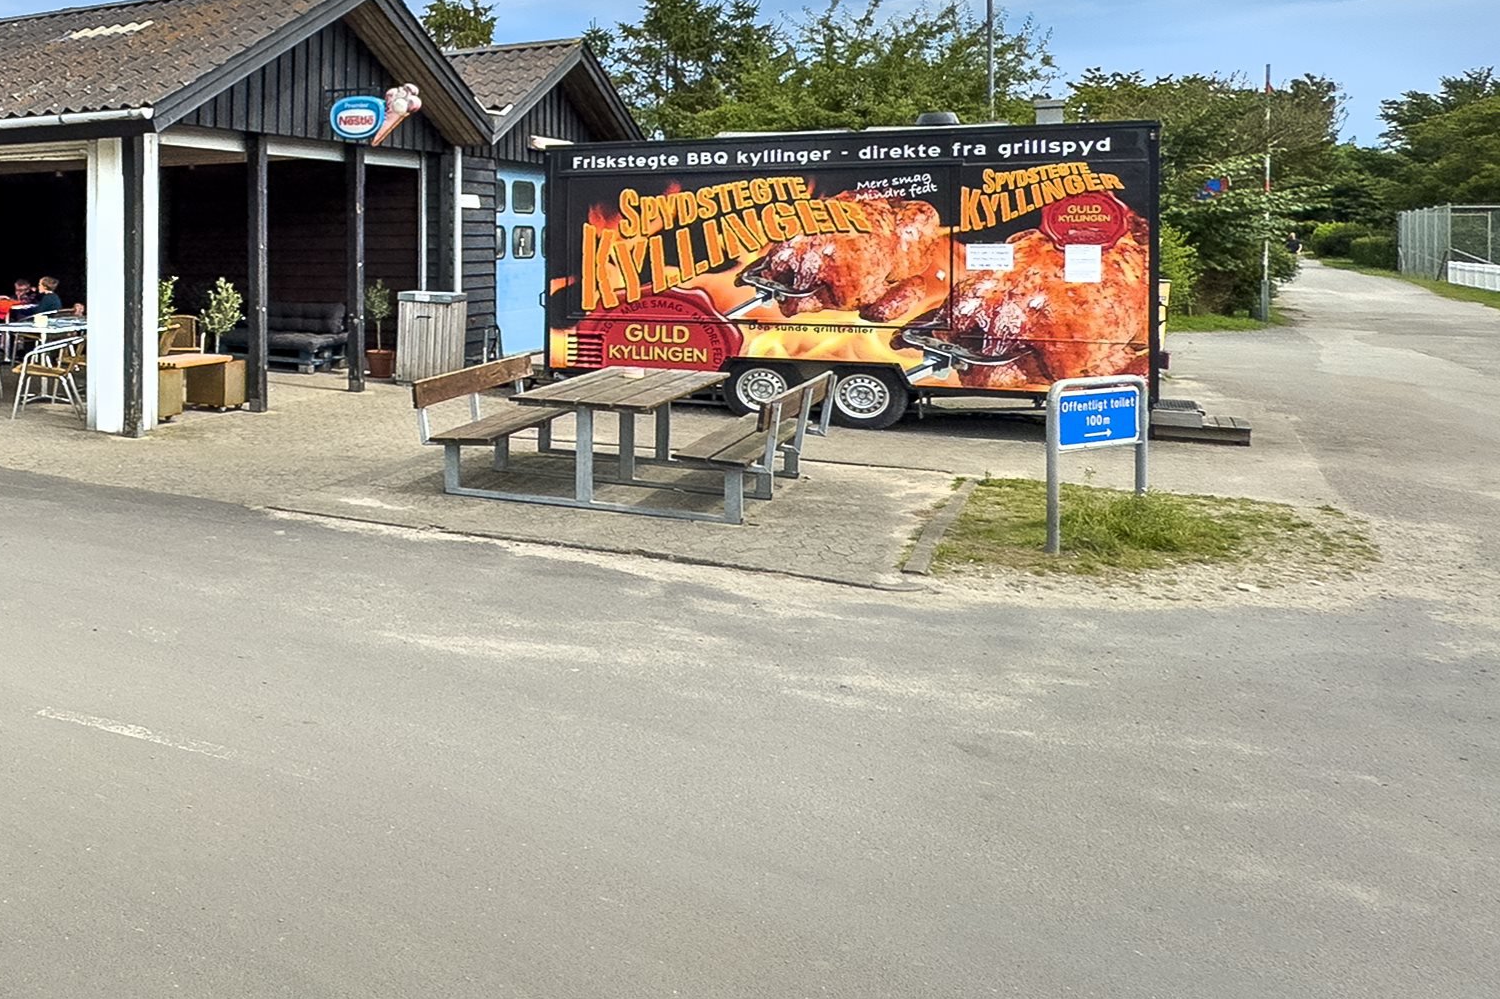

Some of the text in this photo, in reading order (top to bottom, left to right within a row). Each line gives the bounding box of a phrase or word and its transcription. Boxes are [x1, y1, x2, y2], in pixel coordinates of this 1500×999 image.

[572, 153, 679, 170] Friskstegte
[687, 151, 729, 166] BBQ
[737, 149, 831, 167] kyllinger
[858, 144, 941, 159] direkte
[952, 142, 987, 157] fra
[998, 137, 1111, 158] grillspyd
[855, 182, 938, 201] Mindre fedt
[856, 173, 932, 191] Mere smag
[960, 173, 1126, 232] KYLLINGER
[1067, 204, 1102, 214] GULD
[1058, 214, 1111, 223] KYLLINGEN
[581, 198, 873, 312] KYLLINGER
[650, 300, 684, 312] SMAG
[624, 323, 690, 344] GULD
[608, 344, 708, 364] KYLLINGEN
[1061, 396, 1135, 413] Offentligt toilet
